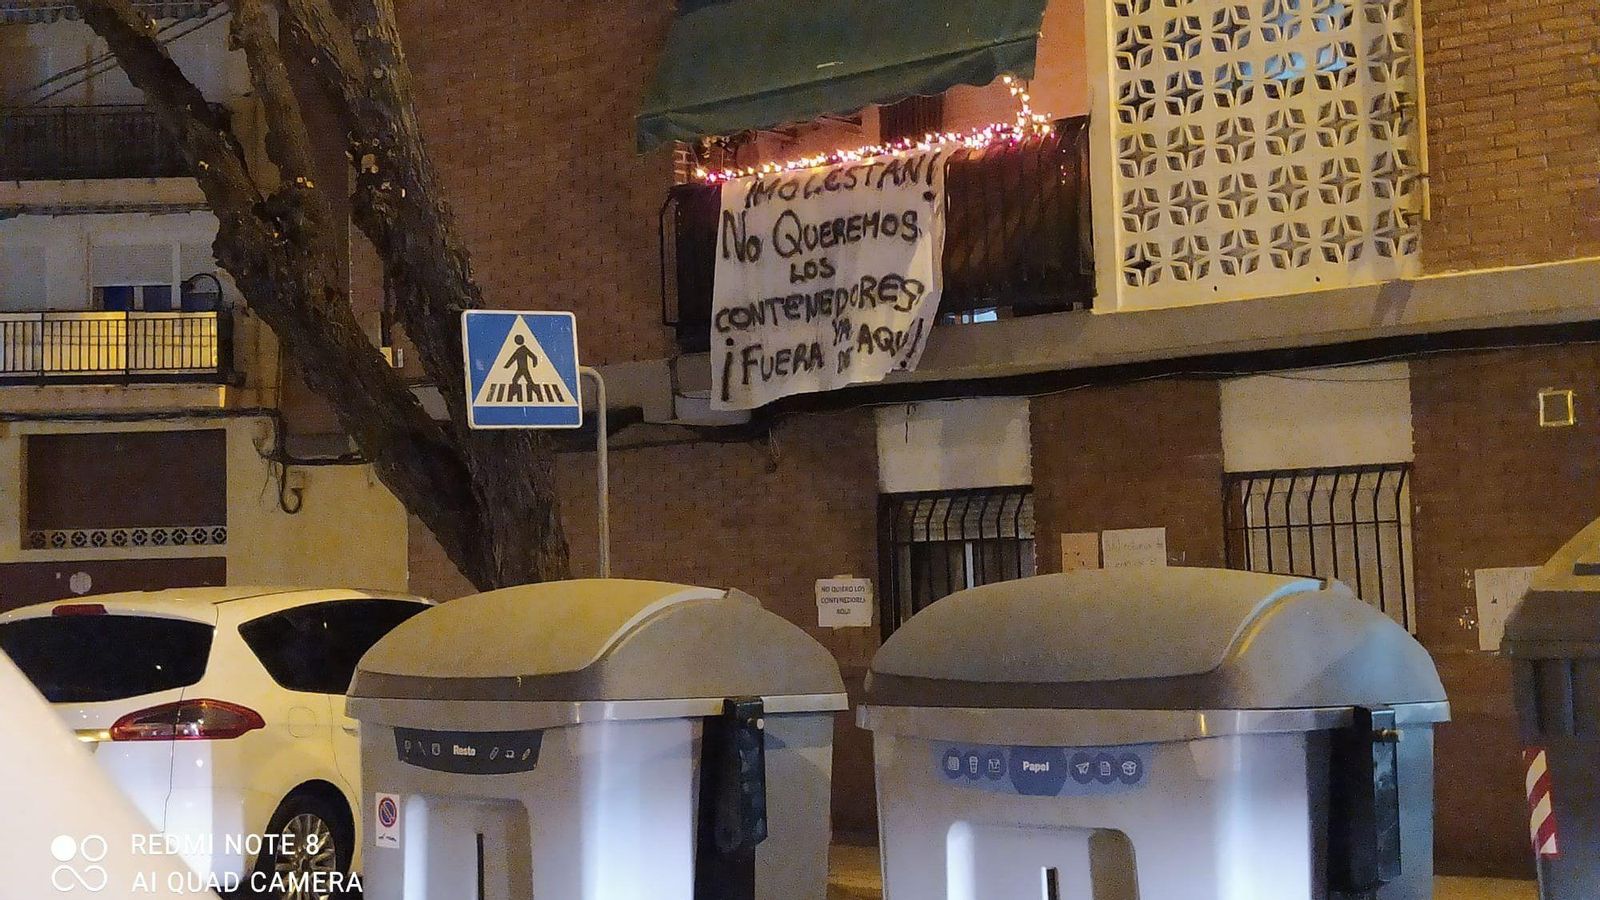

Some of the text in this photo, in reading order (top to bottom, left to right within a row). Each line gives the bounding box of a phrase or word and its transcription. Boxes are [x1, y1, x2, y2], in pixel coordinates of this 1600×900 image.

[772, 208, 920, 258] QUEREMOS
[789, 257, 836, 283] LOS
[715, 272, 925, 333] CONTENEDORES
[721, 337, 824, 401] ¡FUERA
[453, 745, 476, 756] Resto
[1022, 761, 1049, 773] Papel
